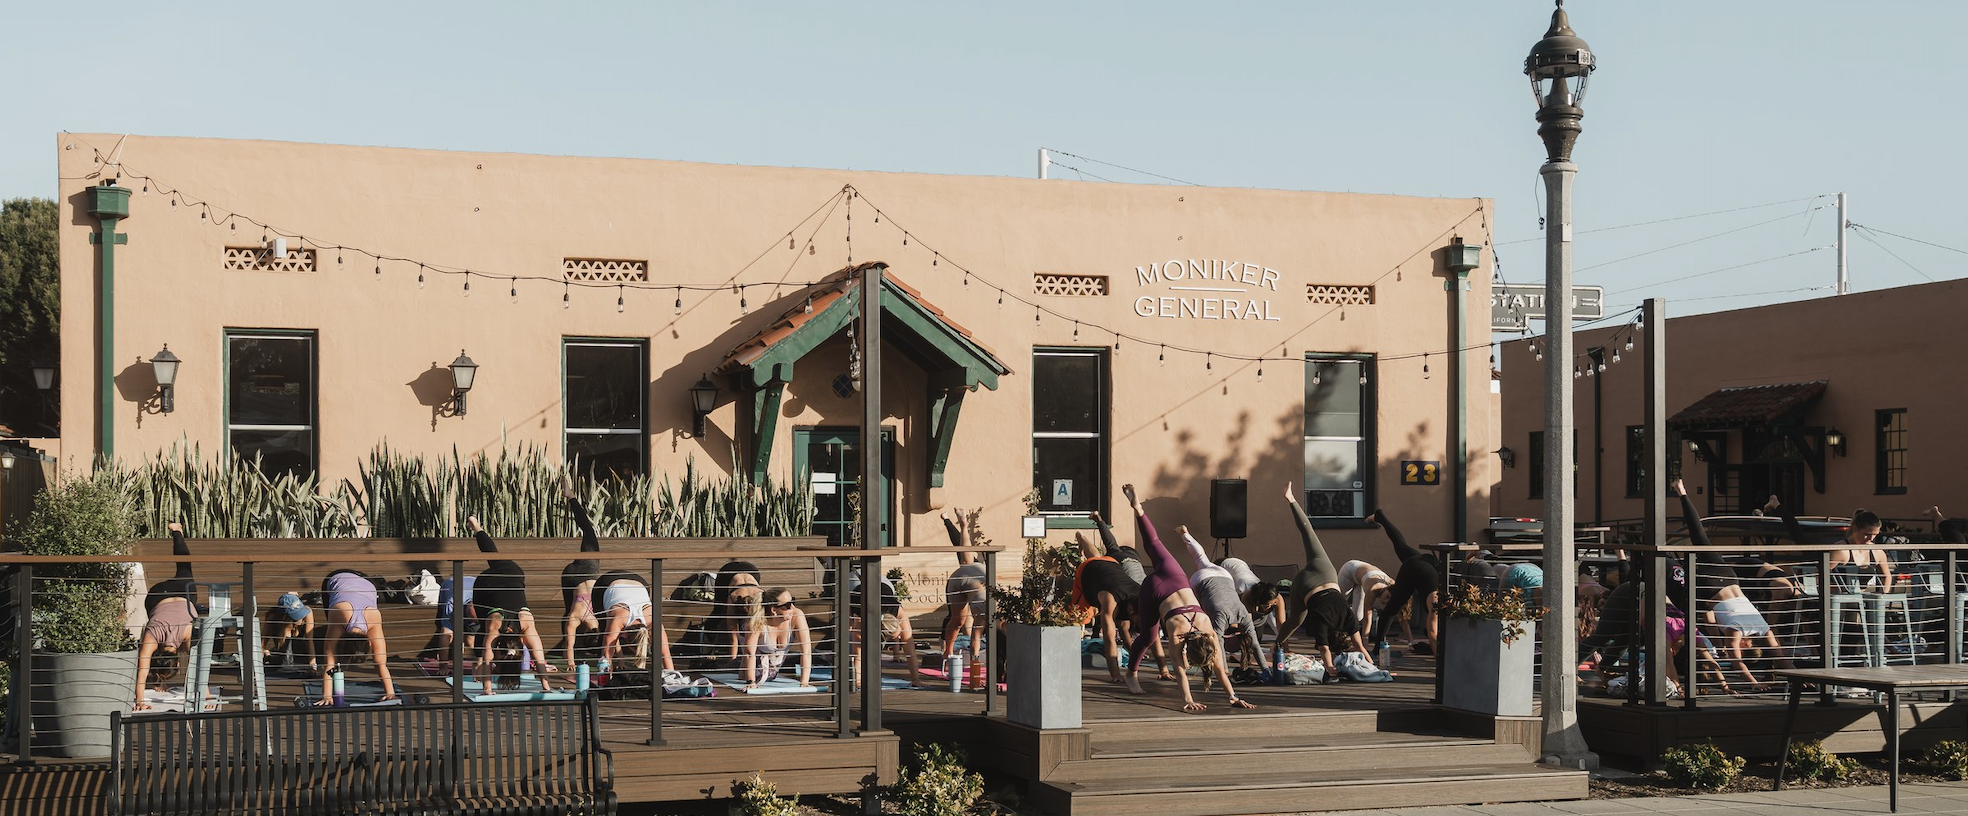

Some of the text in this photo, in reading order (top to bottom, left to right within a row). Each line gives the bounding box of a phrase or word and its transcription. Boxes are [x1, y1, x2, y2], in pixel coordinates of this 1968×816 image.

[1135, 259, 1280, 292] MONIKER
[1134, 296, 1281, 321] GENERAL
[1491, 294, 1577, 309] STATI
[1405, 463, 1436, 482] 23
[1057, 483, 1068, 496] A
